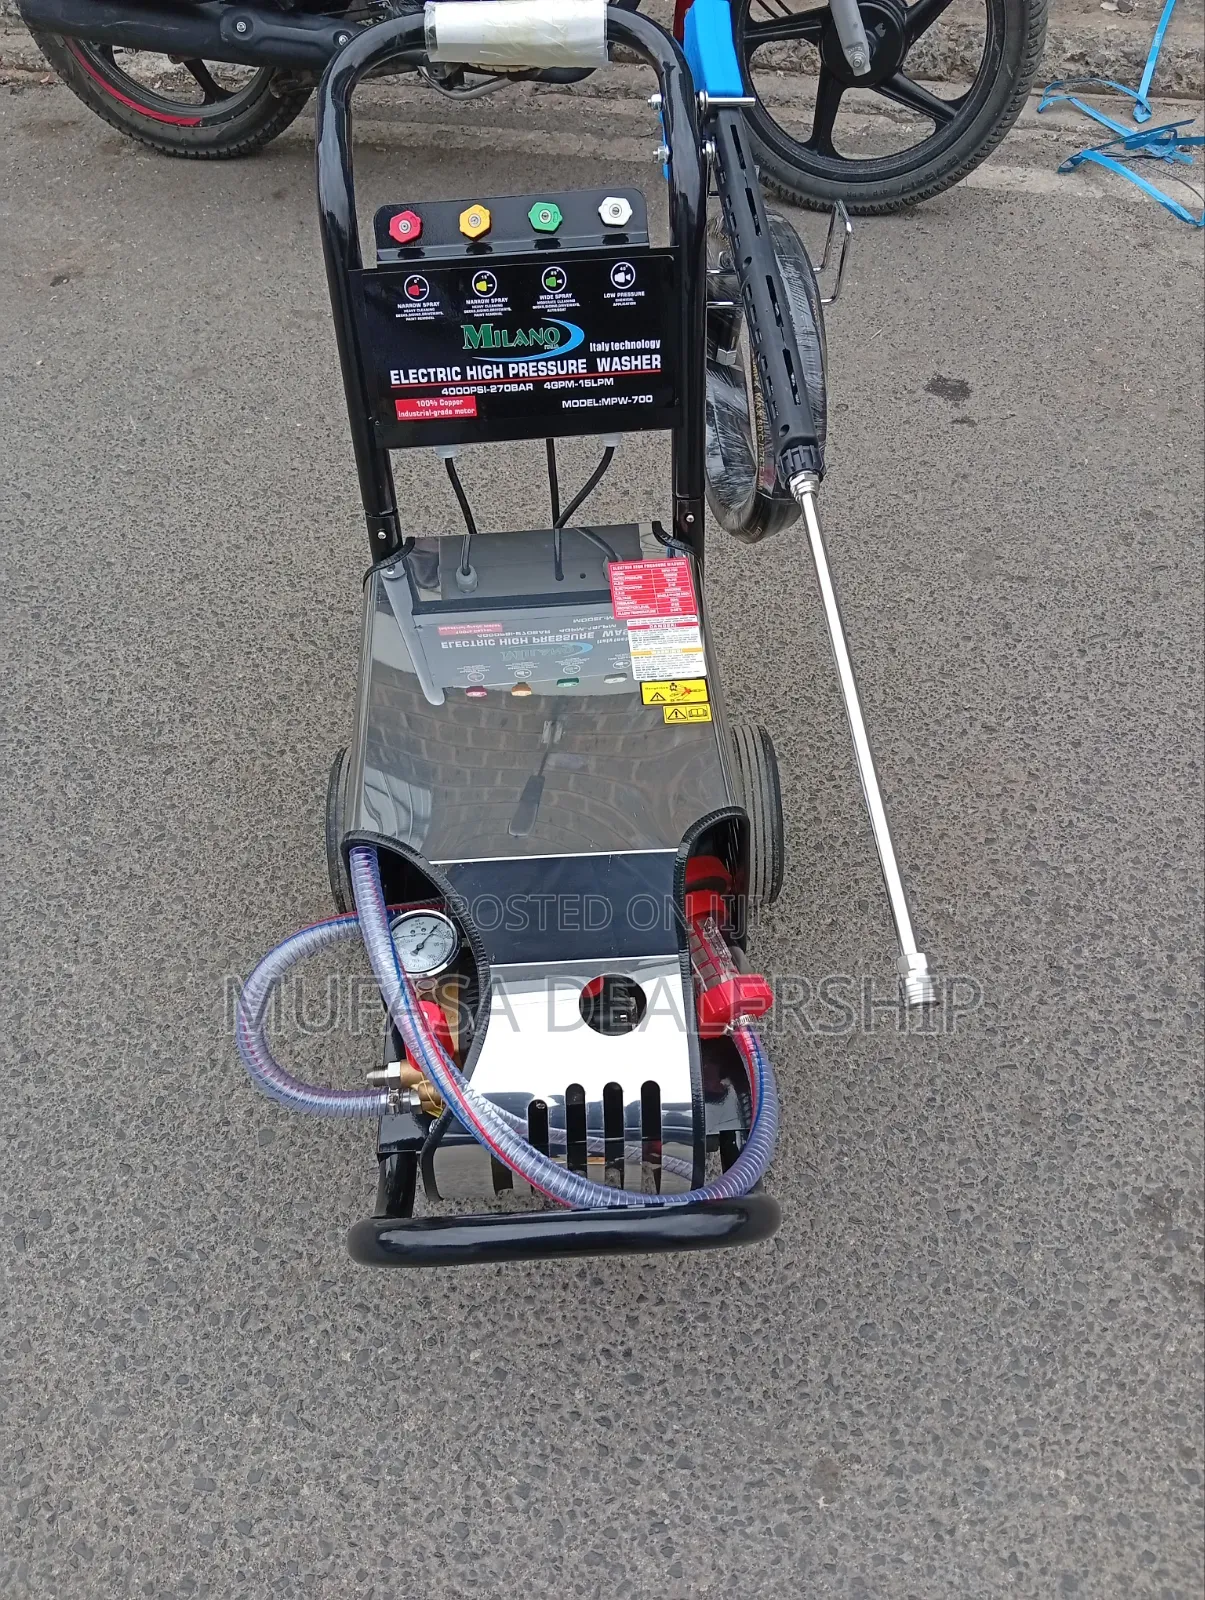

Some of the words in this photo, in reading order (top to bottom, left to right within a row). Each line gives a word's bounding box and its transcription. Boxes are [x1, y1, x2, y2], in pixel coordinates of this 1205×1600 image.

[460, 323, 560, 350] MILANO
[589, 342, 610, 352] Italy
[611, 339, 661, 351] technology
[390, 366, 461, 384] ELECTRIC
[466, 364, 503, 380] HIGH
[508, 358, 587, 378] PRESSURE
[596, 354, 661, 372] WASHER
[441, 383, 533, 395] 4000PSI-270BAR
[543, 378, 614, 390] 4GPM-15LPM
[562, 395, 653, 408] MODEL:MPW-700
